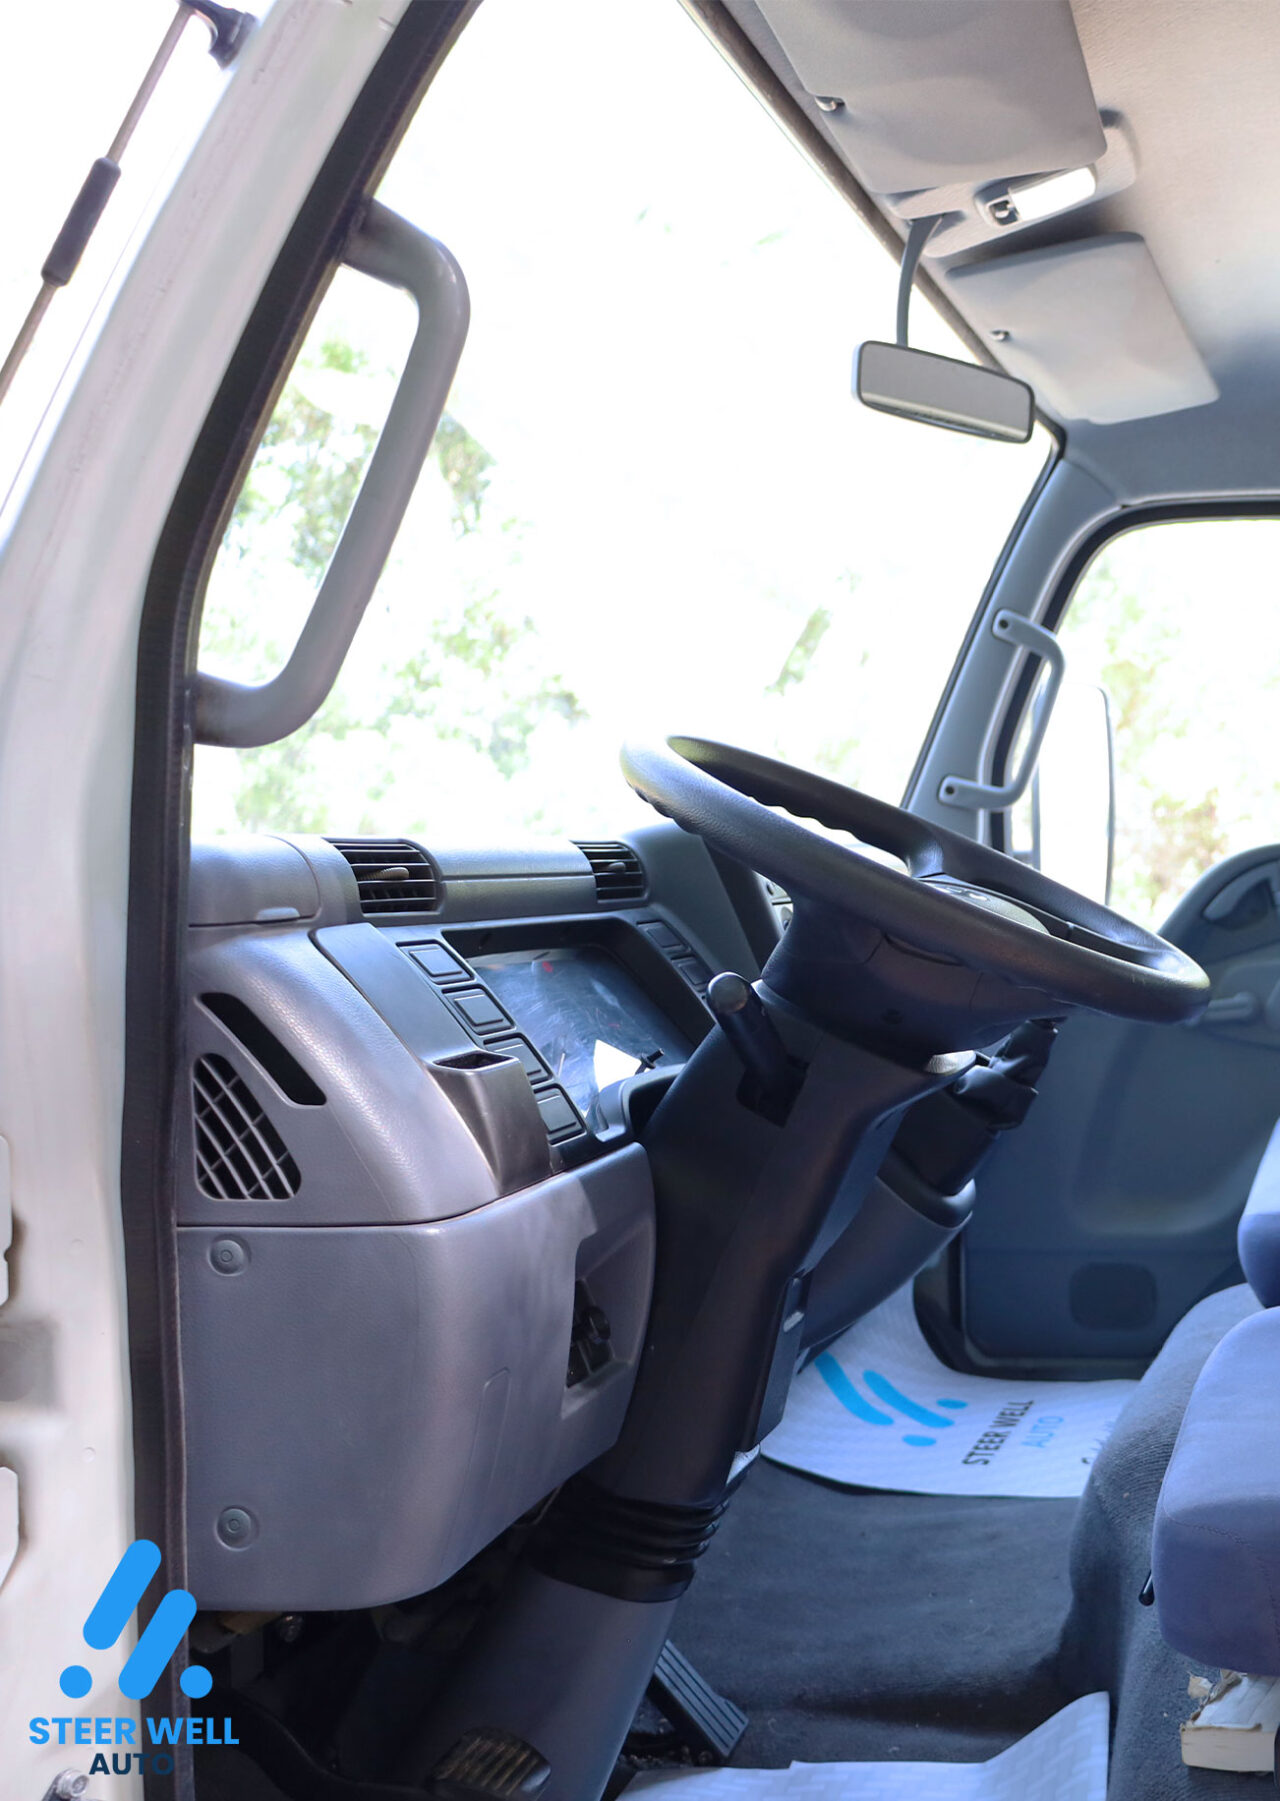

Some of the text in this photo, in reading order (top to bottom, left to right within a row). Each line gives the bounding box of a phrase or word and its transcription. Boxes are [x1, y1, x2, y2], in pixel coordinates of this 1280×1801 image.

[962, 1400, 1034, 1465] STEER WELL
[1020, 1416, 1064, 1448] AUTO
